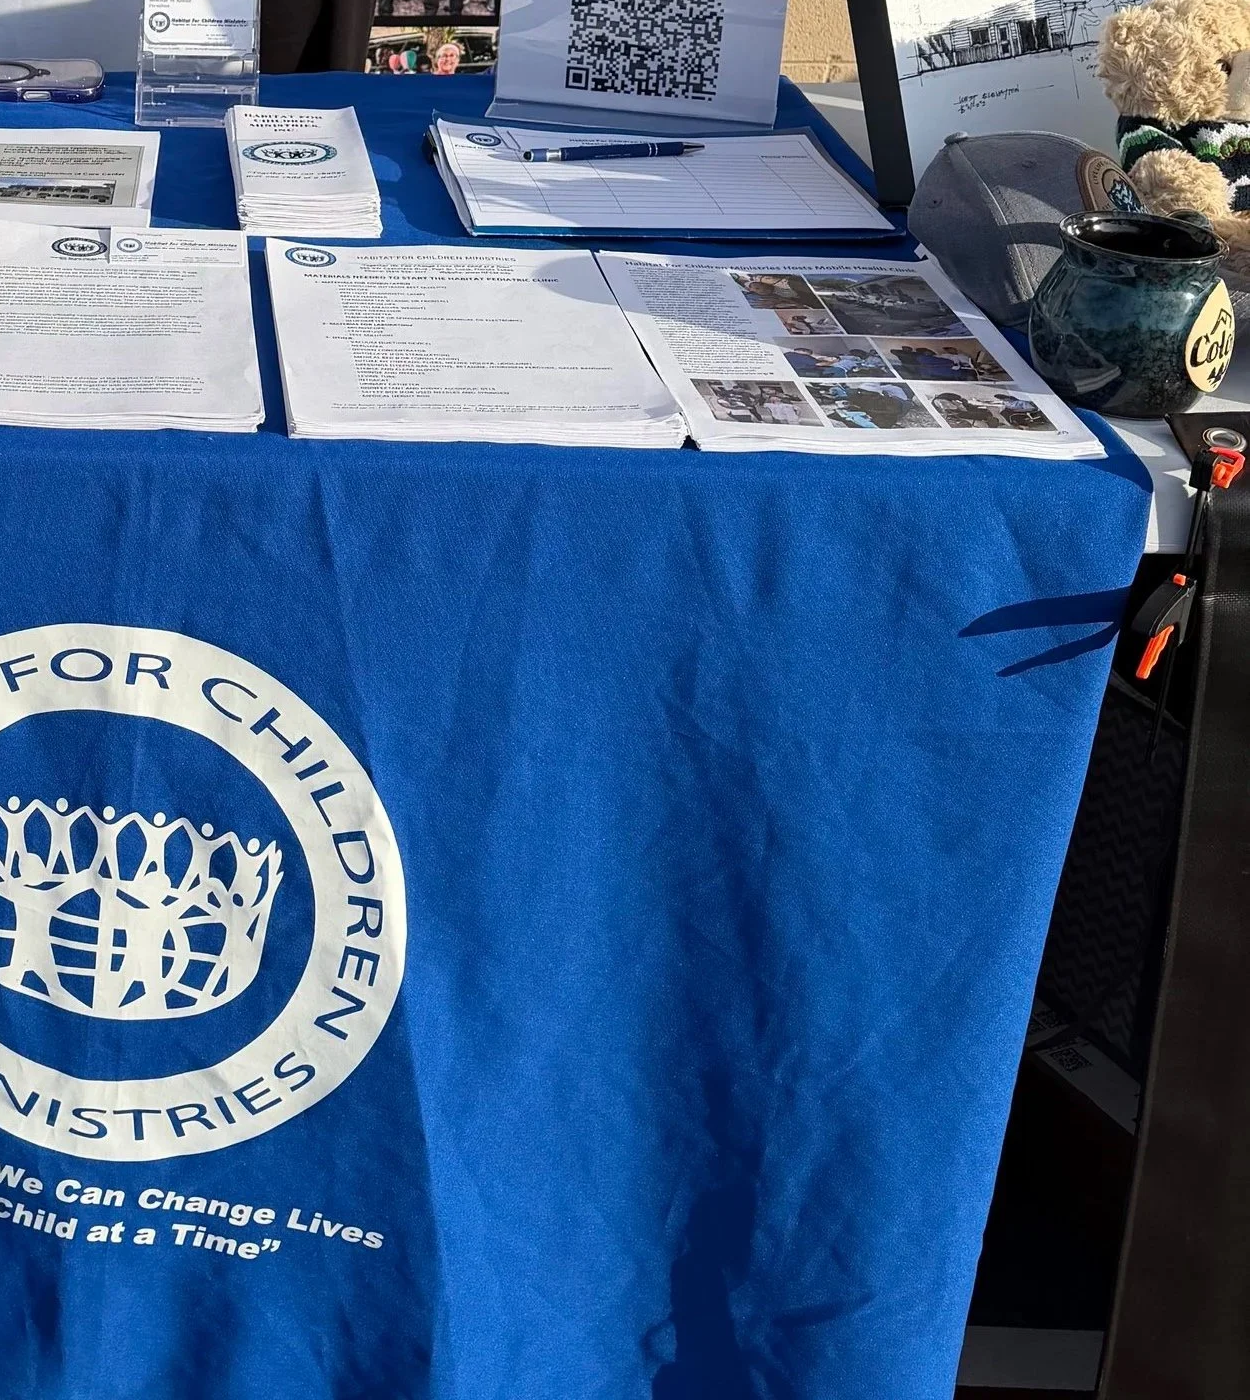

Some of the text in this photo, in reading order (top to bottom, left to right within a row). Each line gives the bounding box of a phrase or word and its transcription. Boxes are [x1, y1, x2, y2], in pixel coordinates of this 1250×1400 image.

[200, 676, 385, 1042] CHILDREN
[54, 1178, 125, 1208] Can
[137, 1186, 277, 1231] Change
[286, 1208, 386, 1250] Lives
[85, 1221, 125, 1244] at
[132, 1226, 156, 1247] a
[170, 1222, 282, 1261] Time”
